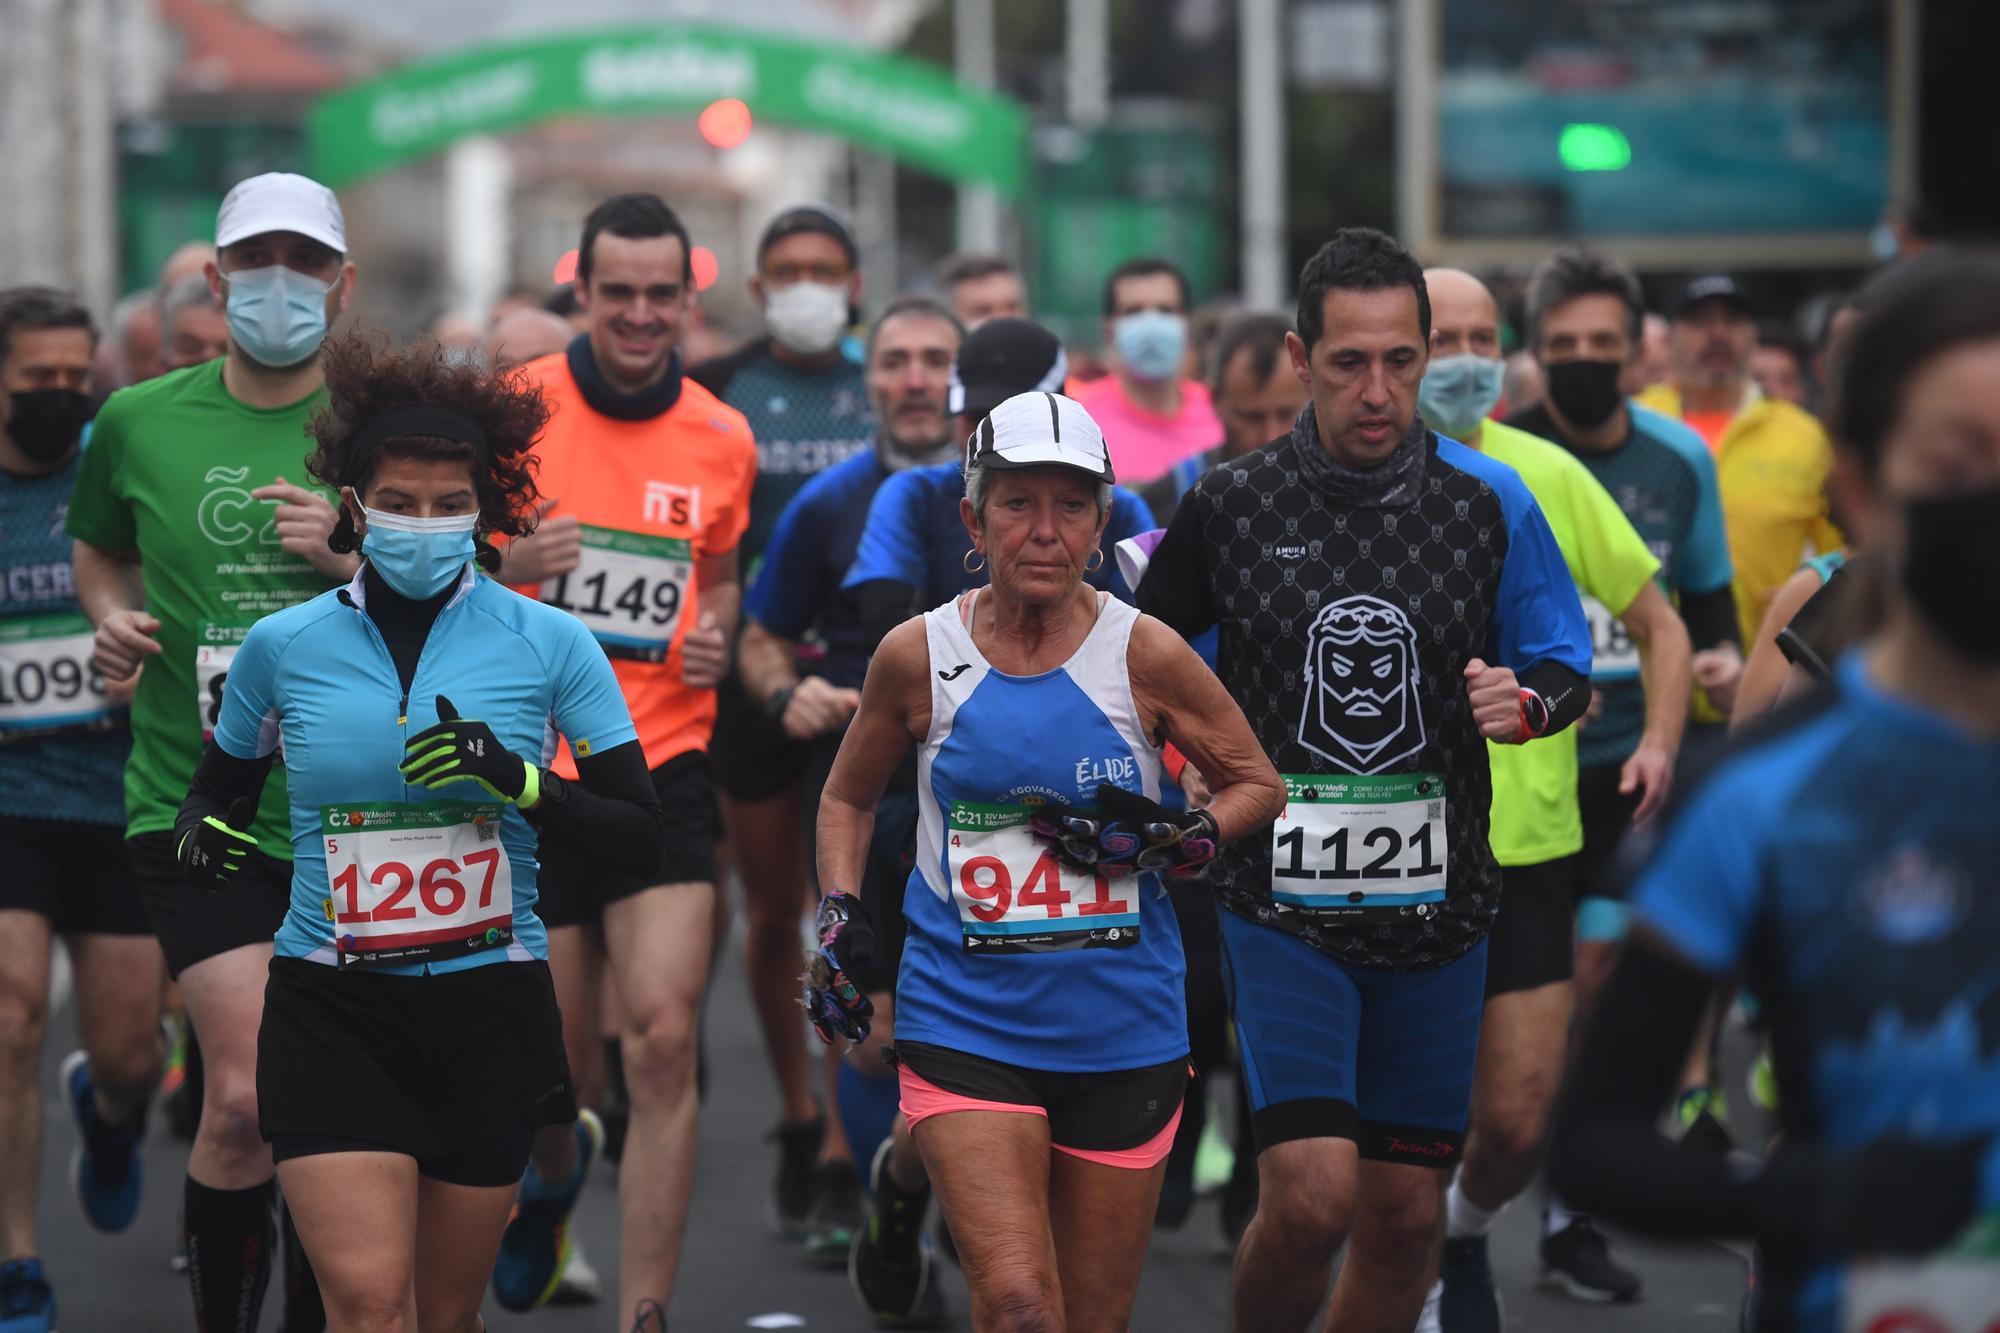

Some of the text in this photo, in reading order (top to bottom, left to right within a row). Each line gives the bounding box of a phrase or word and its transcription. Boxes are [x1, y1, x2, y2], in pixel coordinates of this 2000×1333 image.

[235, 563, 268, 574] Media
[540, 571, 681, 626] 1149
[1075, 756, 1135, 784] ÉLIDE
[1317, 790, 1344, 798] aratón
[1325, 783, 1348, 792] Media
[373, 810, 397, 820] Media
[985, 811, 1023, 821] XIV Media
[361, 817, 393, 827] aratón
[328, 839, 338, 854] 5
[950, 835, 961, 848] 4
[1275, 822, 1443, 879] 1121
[333, 847, 500, 924] 1267
[960, 849, 1128, 923] 941
